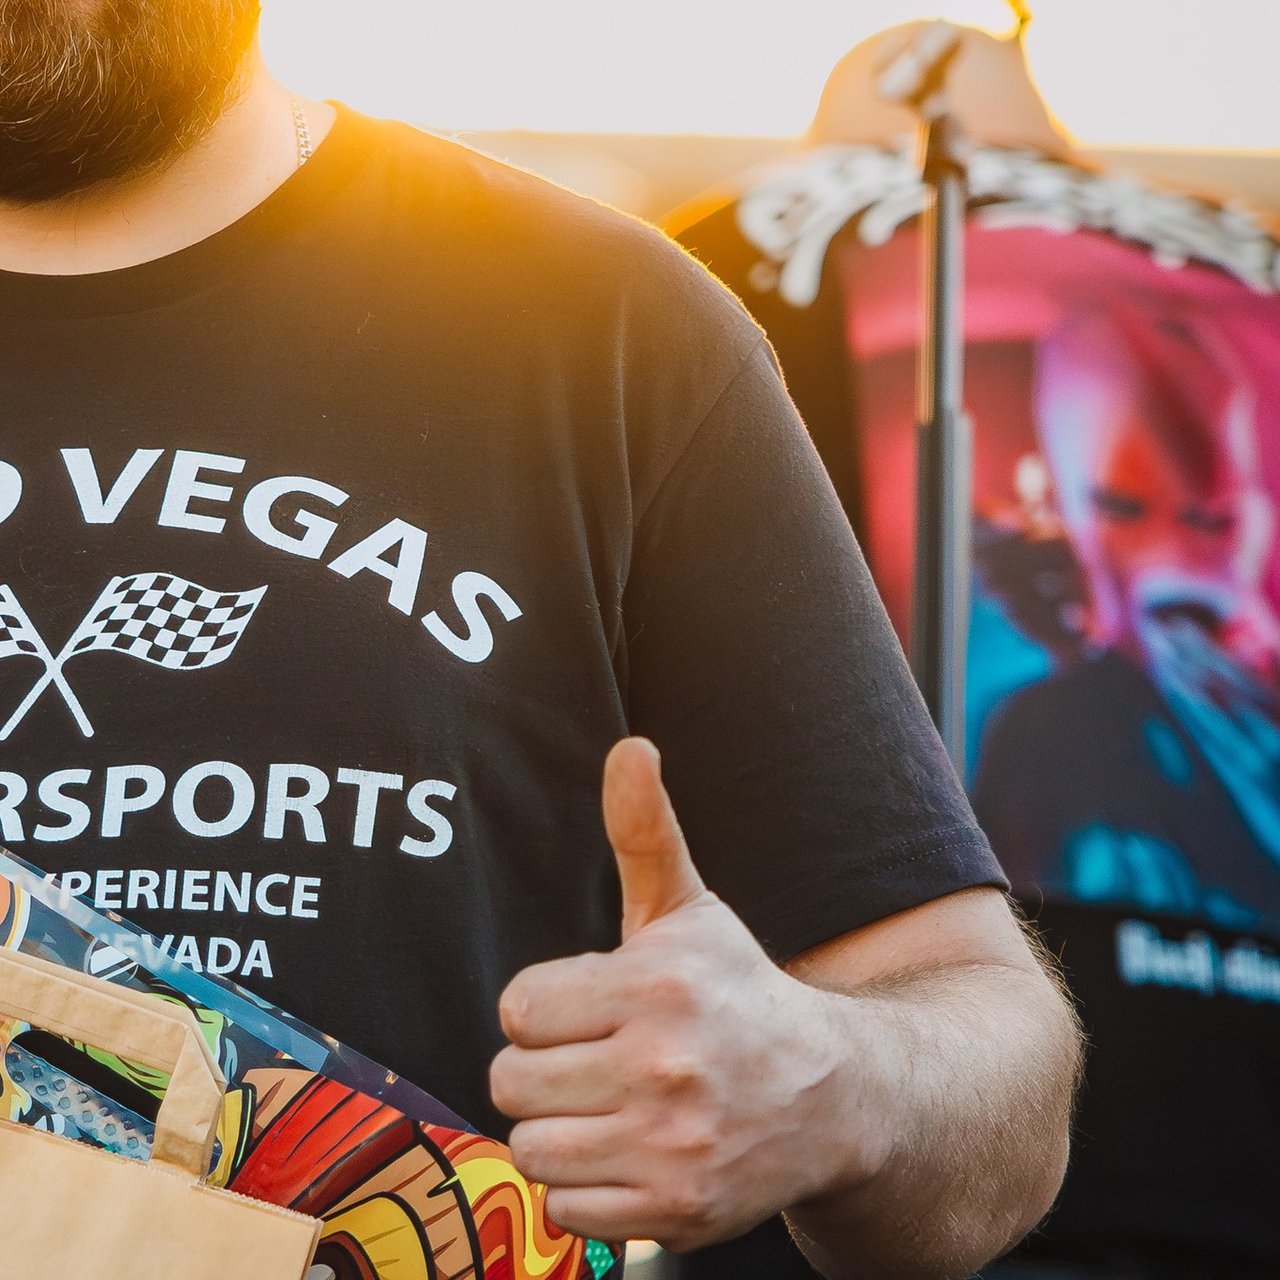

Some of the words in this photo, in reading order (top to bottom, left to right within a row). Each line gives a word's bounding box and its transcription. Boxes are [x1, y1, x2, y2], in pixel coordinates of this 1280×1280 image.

[59, 447, 524, 664] VEGAS
[42, 869, 322, 920] PERIENCE
[100, 932, 274, 978] EVADA
